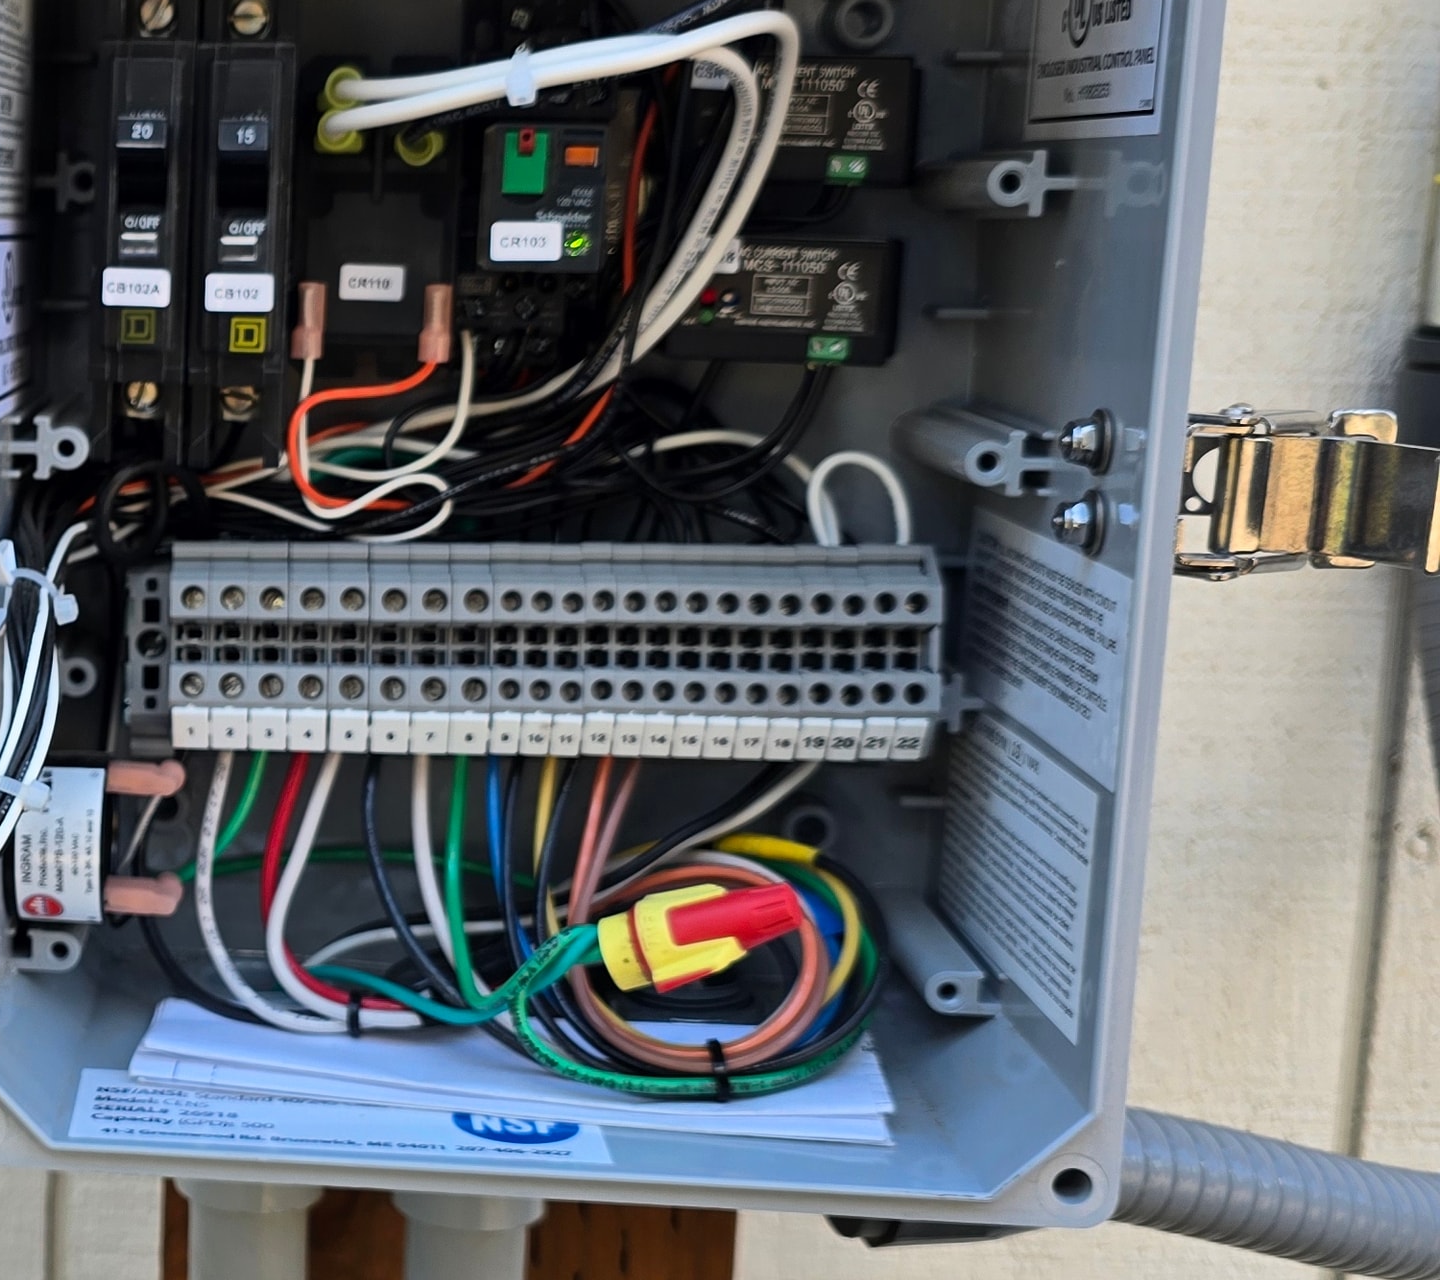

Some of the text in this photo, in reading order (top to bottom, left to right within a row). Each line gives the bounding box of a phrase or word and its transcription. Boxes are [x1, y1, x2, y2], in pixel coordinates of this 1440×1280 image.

[132, 122, 154, 139] 20
[236, 124, 256, 145] 15
[214, 288, 259, 301] CB102
[225, 726, 235, 737] 2
[590, 732, 607, 743] 12
[621, 733, 637, 744] 13
[802, 735, 825, 750] 19
[831, 736, 854, 750] 20
[863, 736, 887, 750] 21
[895, 737, 920, 751] 22
[91, 1113, 174, 1125] Capacity
